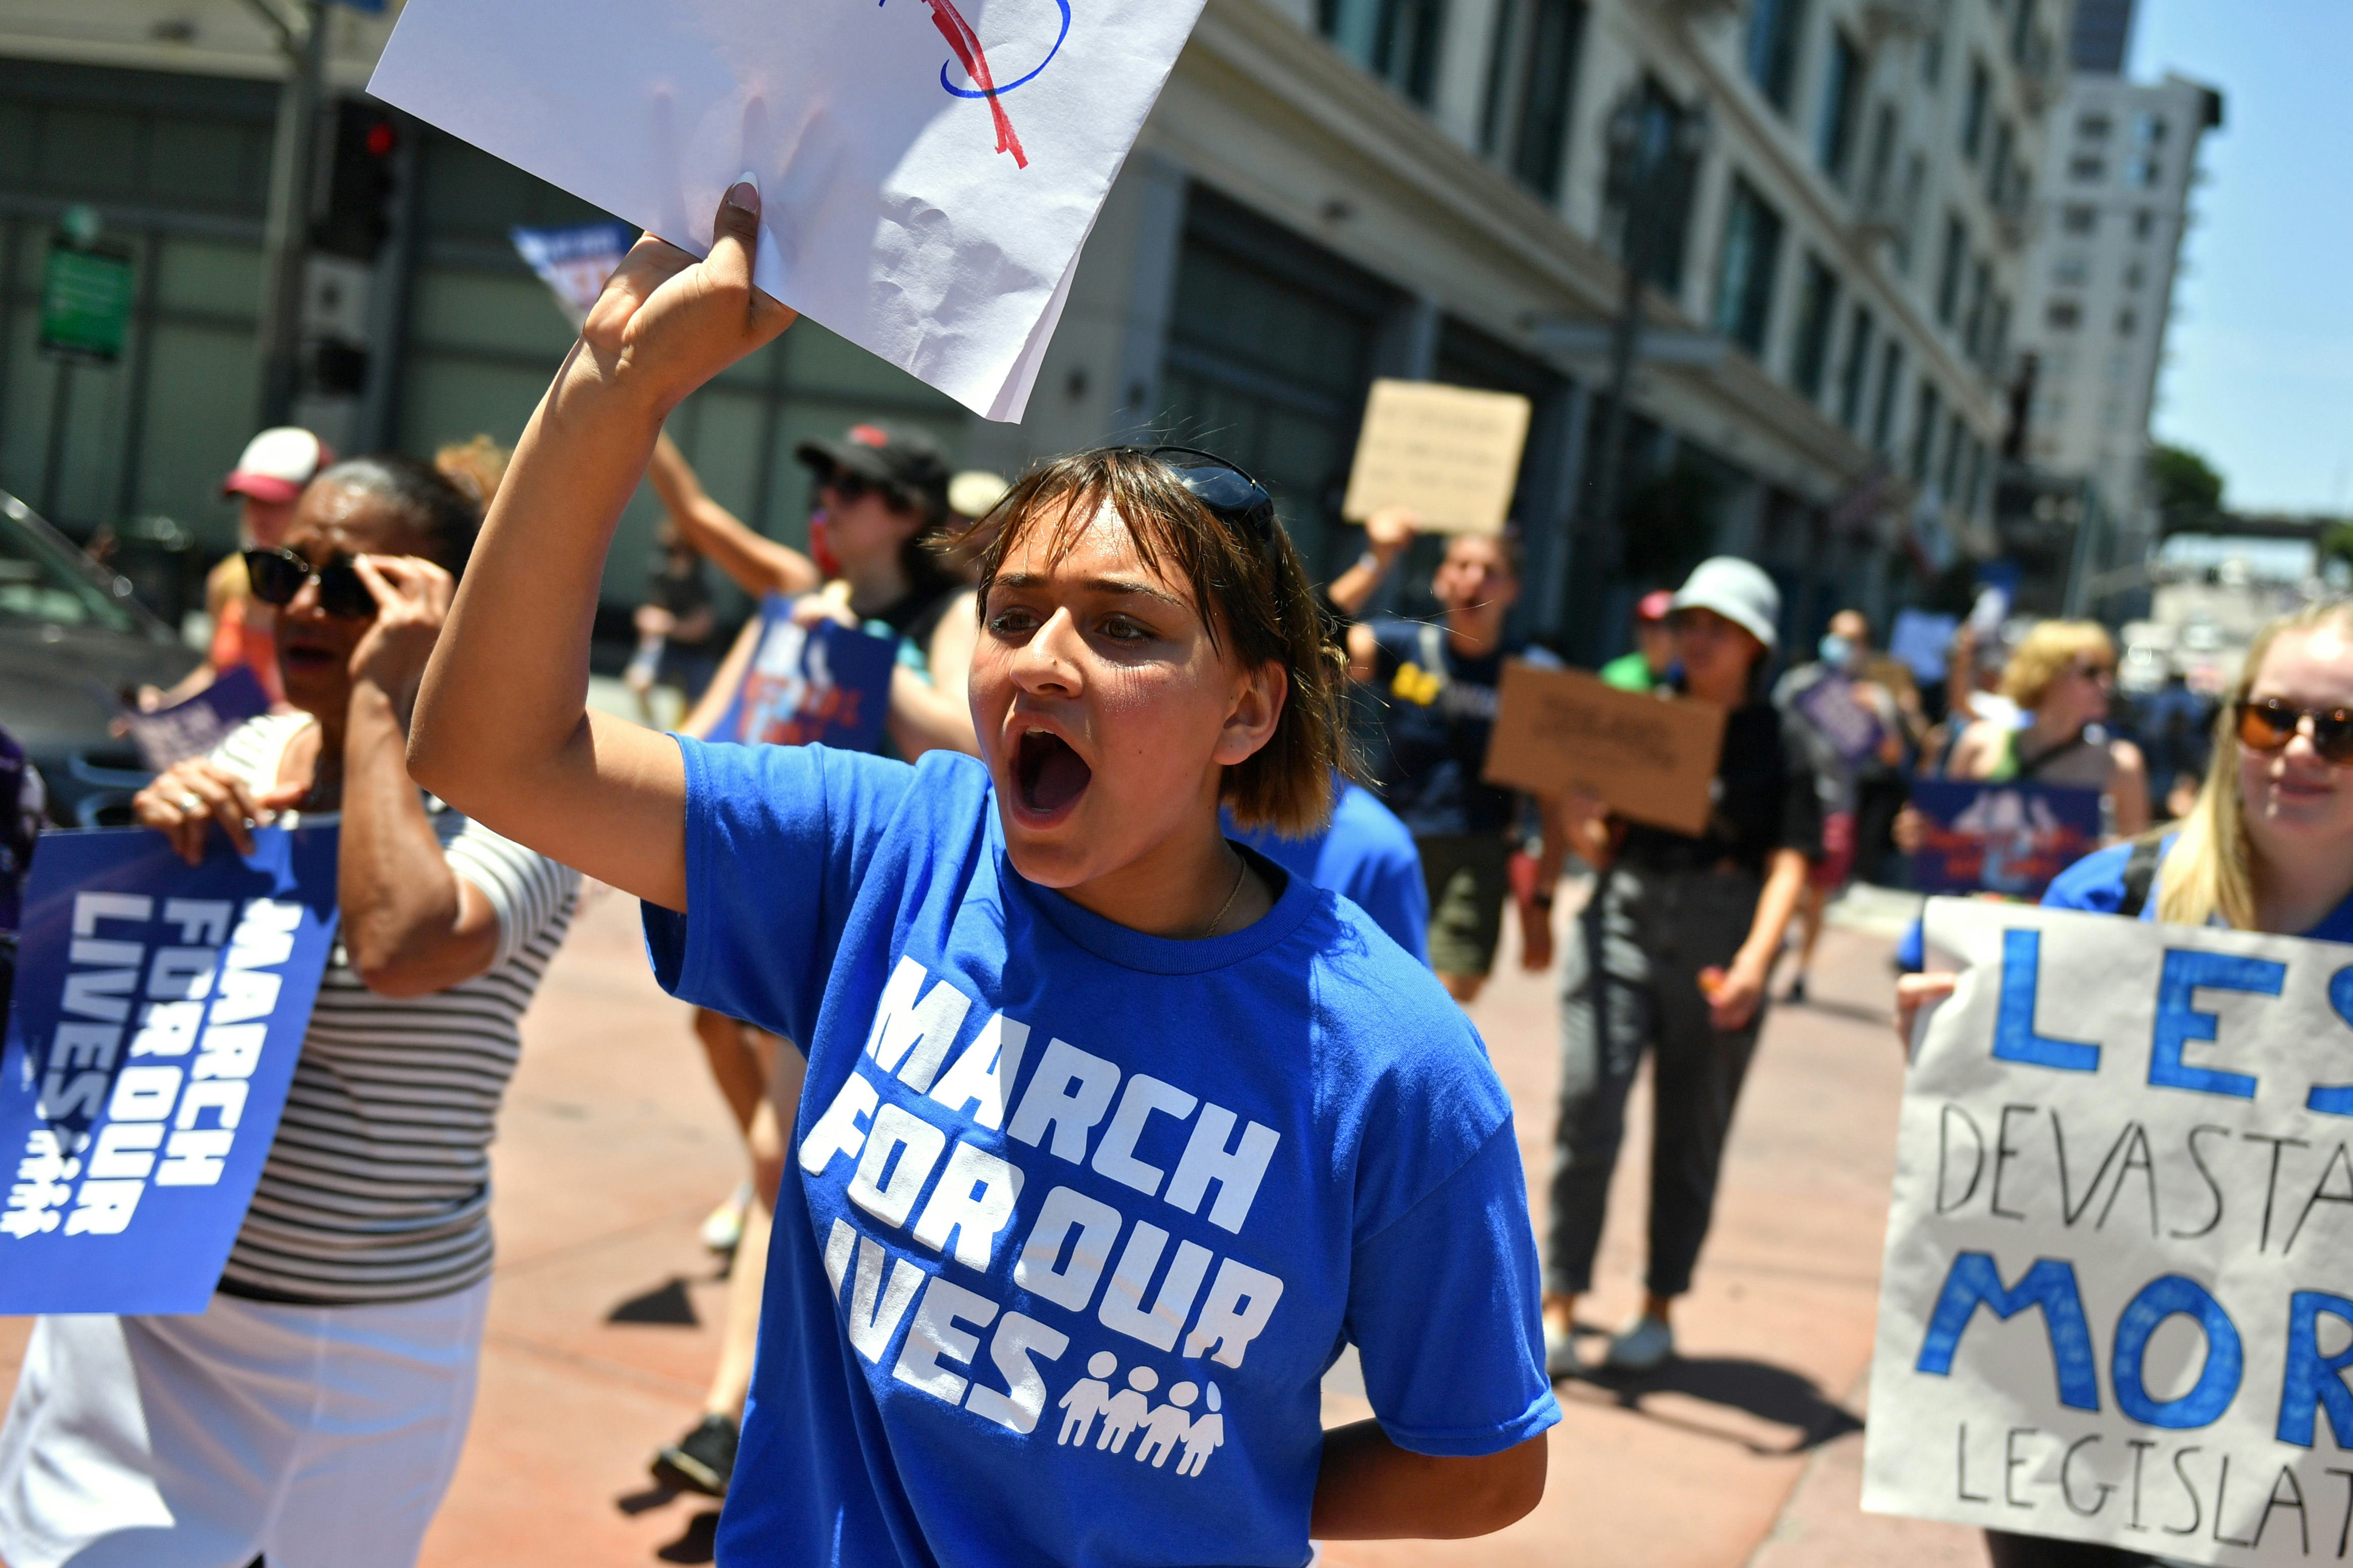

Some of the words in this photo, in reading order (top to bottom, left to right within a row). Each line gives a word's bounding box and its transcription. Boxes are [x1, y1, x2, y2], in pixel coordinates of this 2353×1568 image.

[35, 888, 153, 1120] LIVES
[128, 899, 232, 1058] FOR
[154, 897, 304, 1188] MARCH
[865, 954, 1281, 1235] MARCH
[64, 1065, 184, 1237] OUR
[798, 1071, 1025, 1274] FOR
[1013, 1186, 1284, 1369] OUR
[824, 1217, 1070, 1435] IVES
